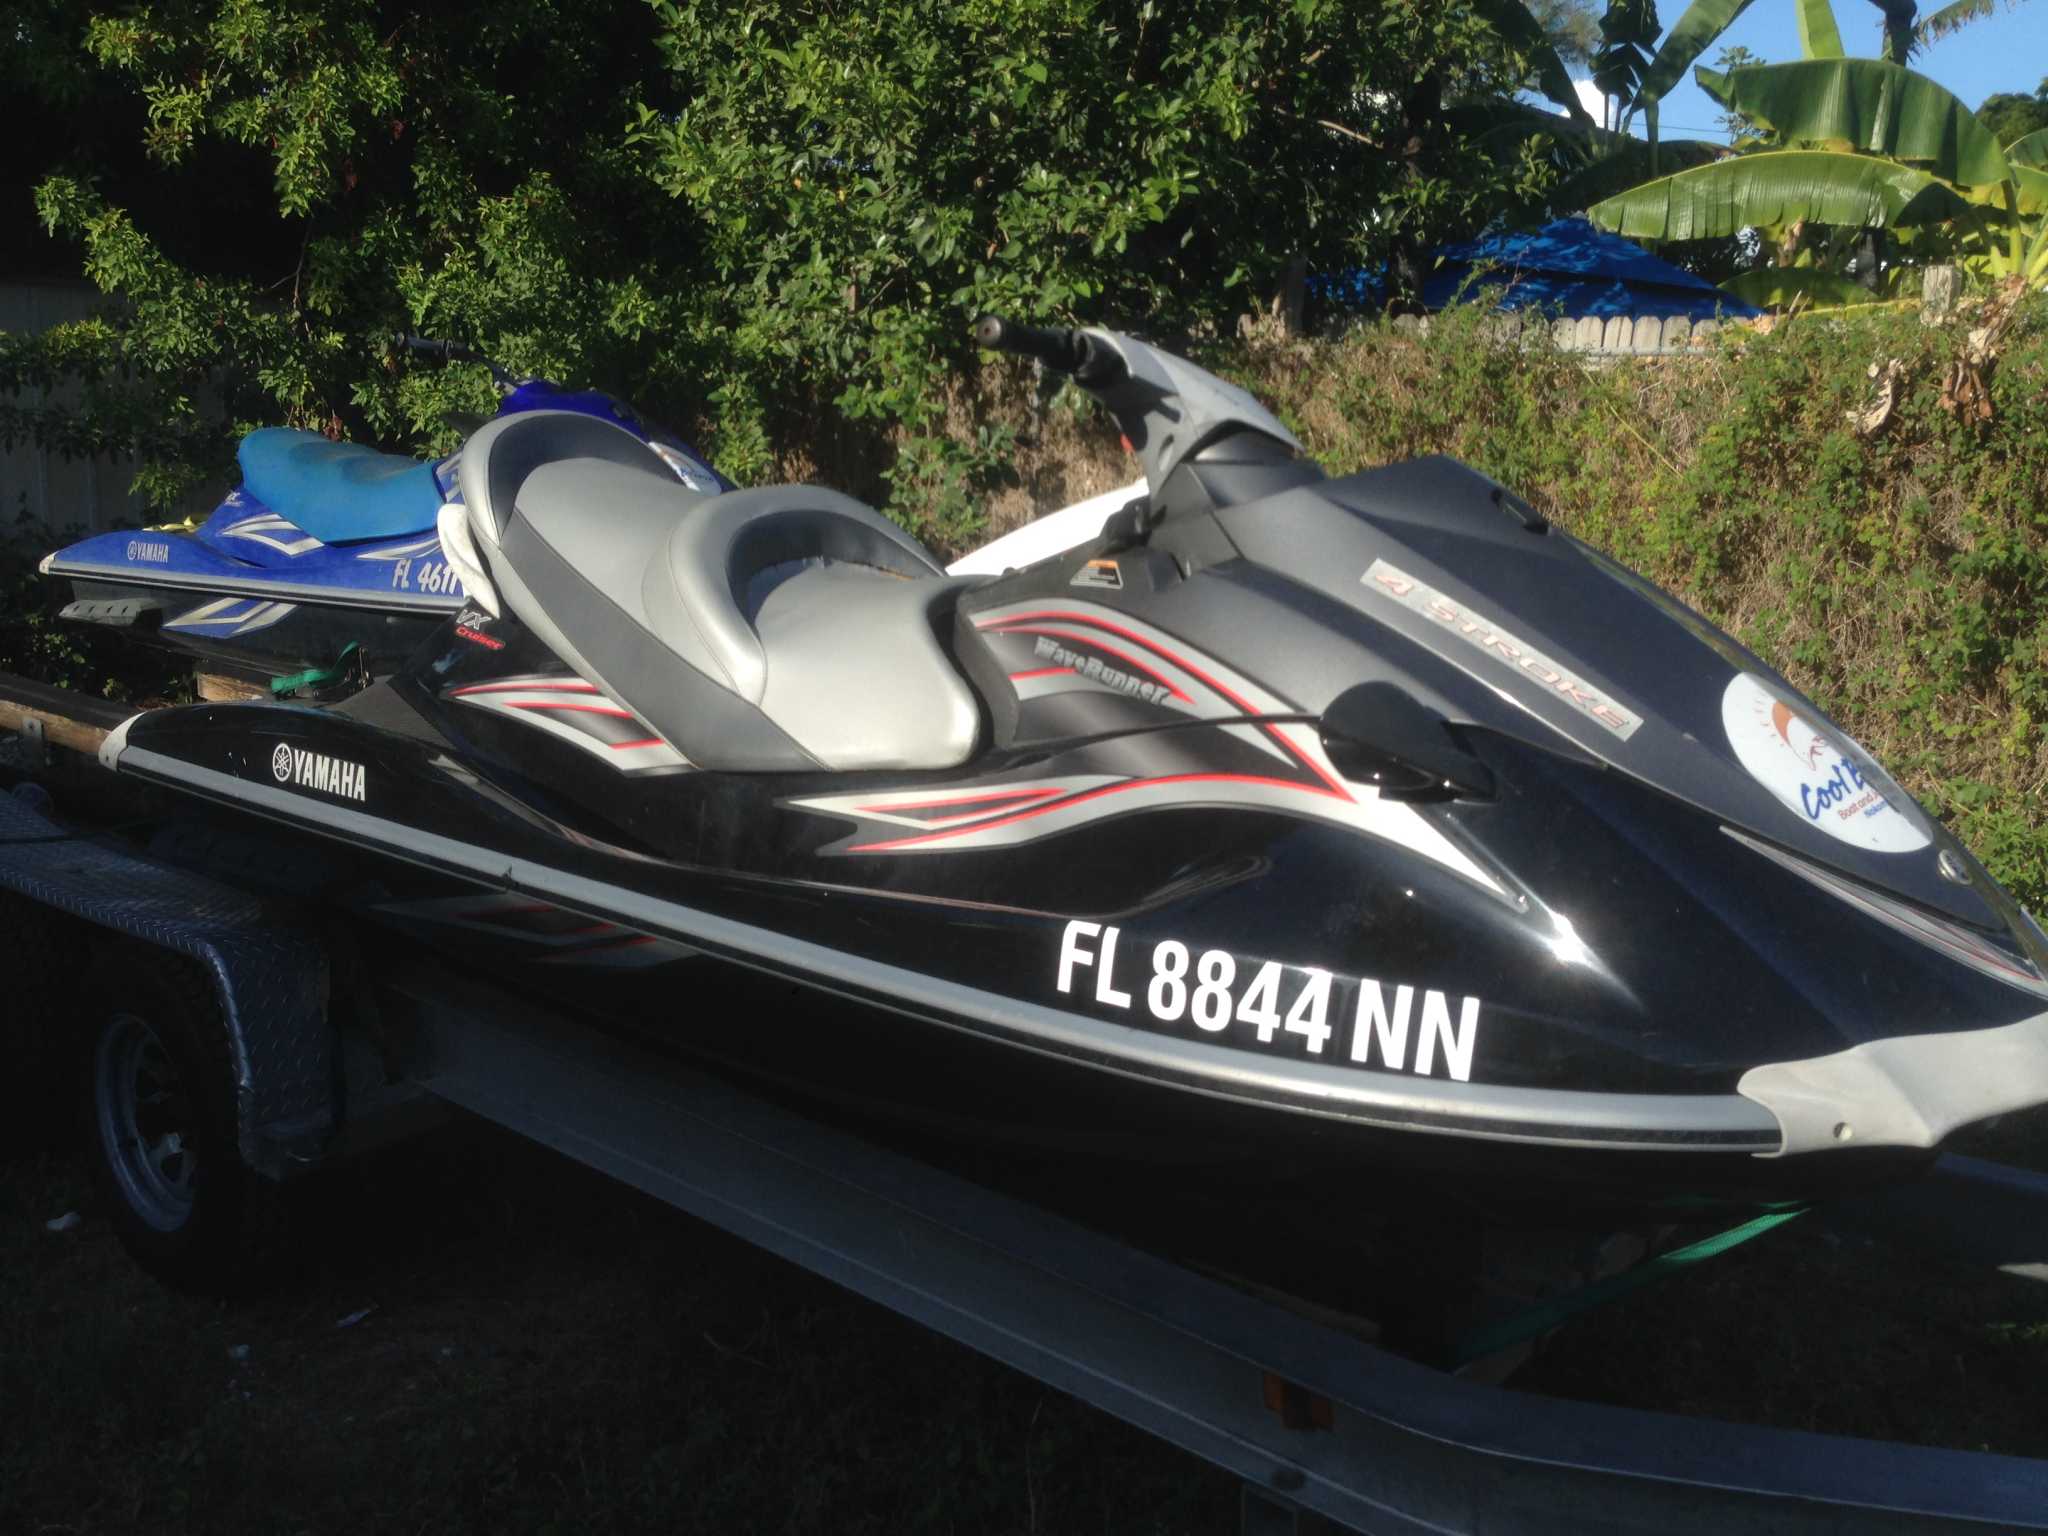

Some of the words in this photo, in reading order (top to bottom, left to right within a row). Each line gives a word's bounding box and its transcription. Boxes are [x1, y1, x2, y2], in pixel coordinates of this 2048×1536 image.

[137, 543, 169, 563] YAMAHA
[392, 559, 412, 588] FL
[456, 609, 492, 630] VX
[456, 626, 505, 650] Cruiser
[1035, 636, 1172, 704] WaveRunner
[1423, 600, 1627, 730] STROKE
[294, 748, 365, 802] YAMAHA
[1801, 765, 1852, 820] Cool
[1057, 920, 1131, 1008] FL
[1148, 940, 1332, 1053] 8844
[1350, 978, 1480, 1081] NN
